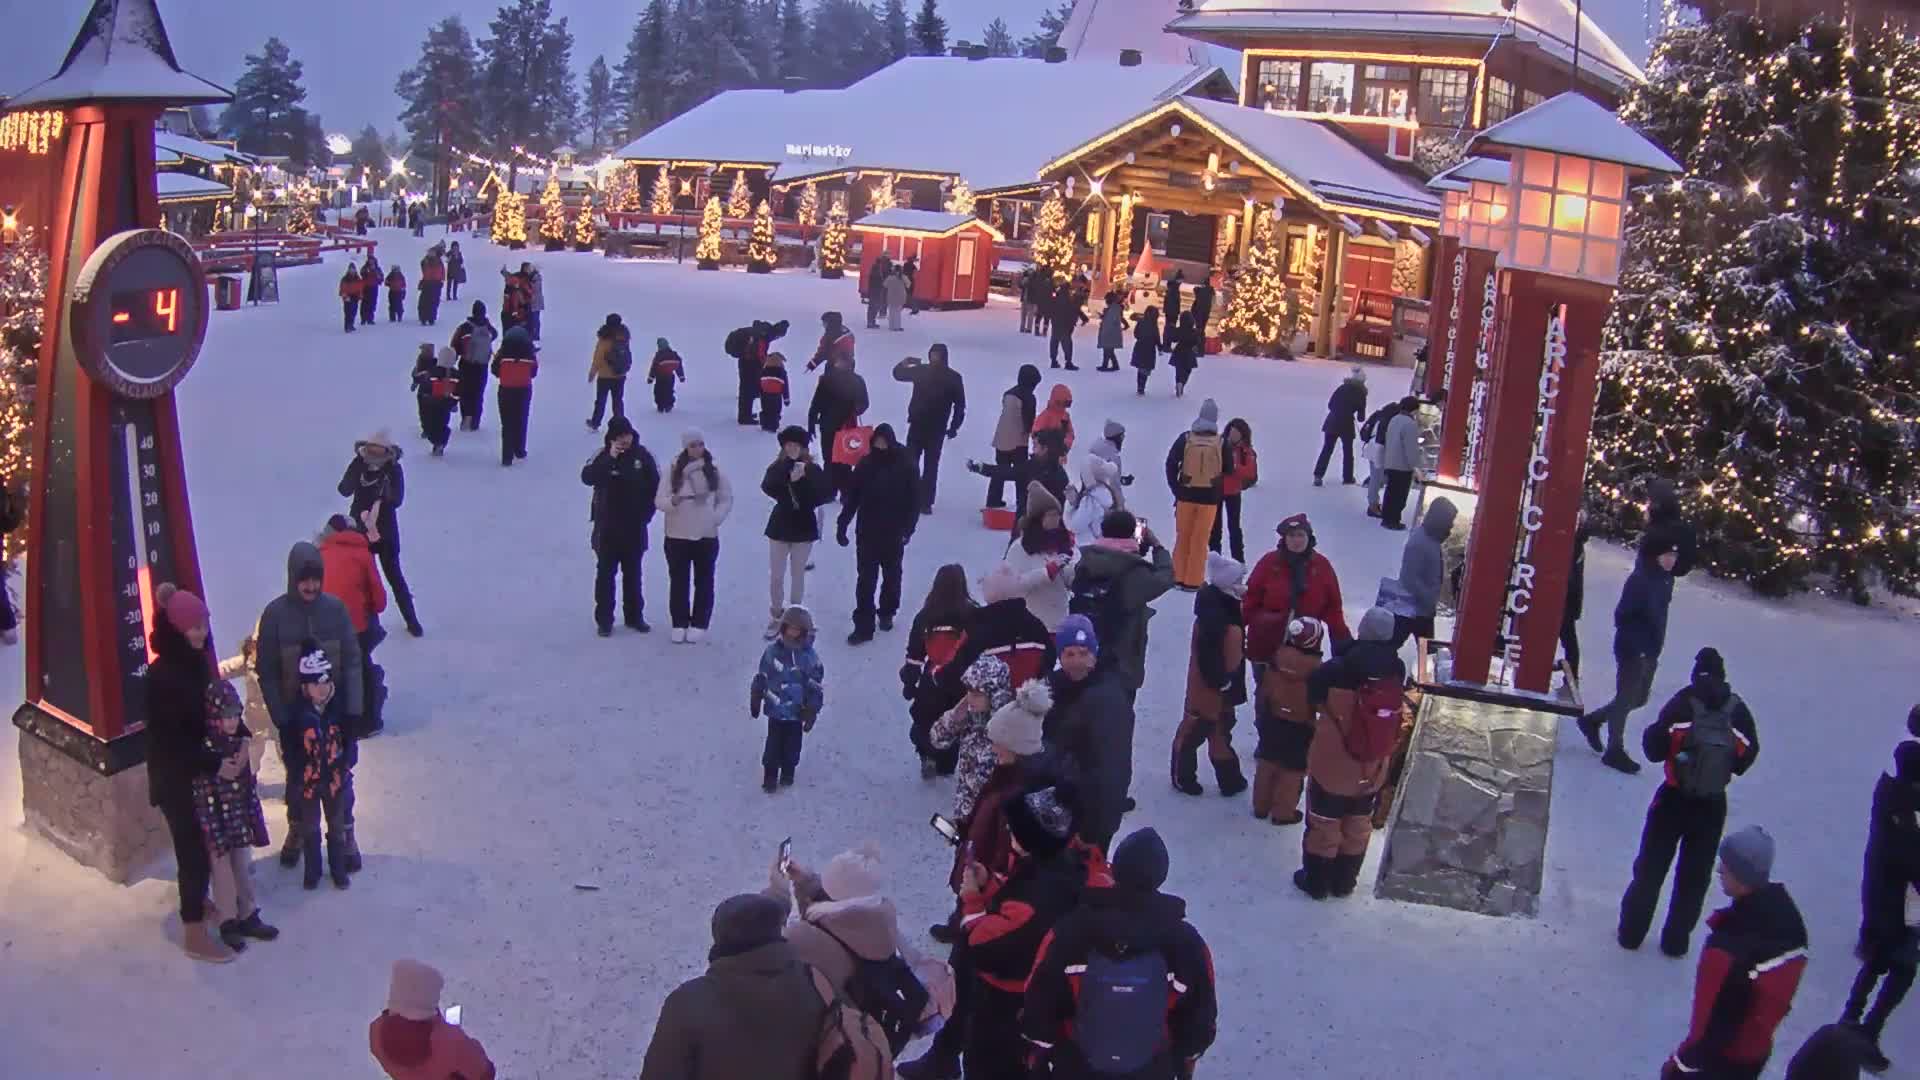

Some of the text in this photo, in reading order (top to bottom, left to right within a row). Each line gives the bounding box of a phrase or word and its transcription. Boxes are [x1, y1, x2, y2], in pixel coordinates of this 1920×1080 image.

[1450, 254, 1463, 319] ARCTIC
[140, 436, 153, 449] 40
[143, 464, 155, 477] 30
[145, 491, 158, 505] 20
[1502, 317, 1567, 668] ARCTIC CIRCLE
[147, 521, 160, 534] 10
